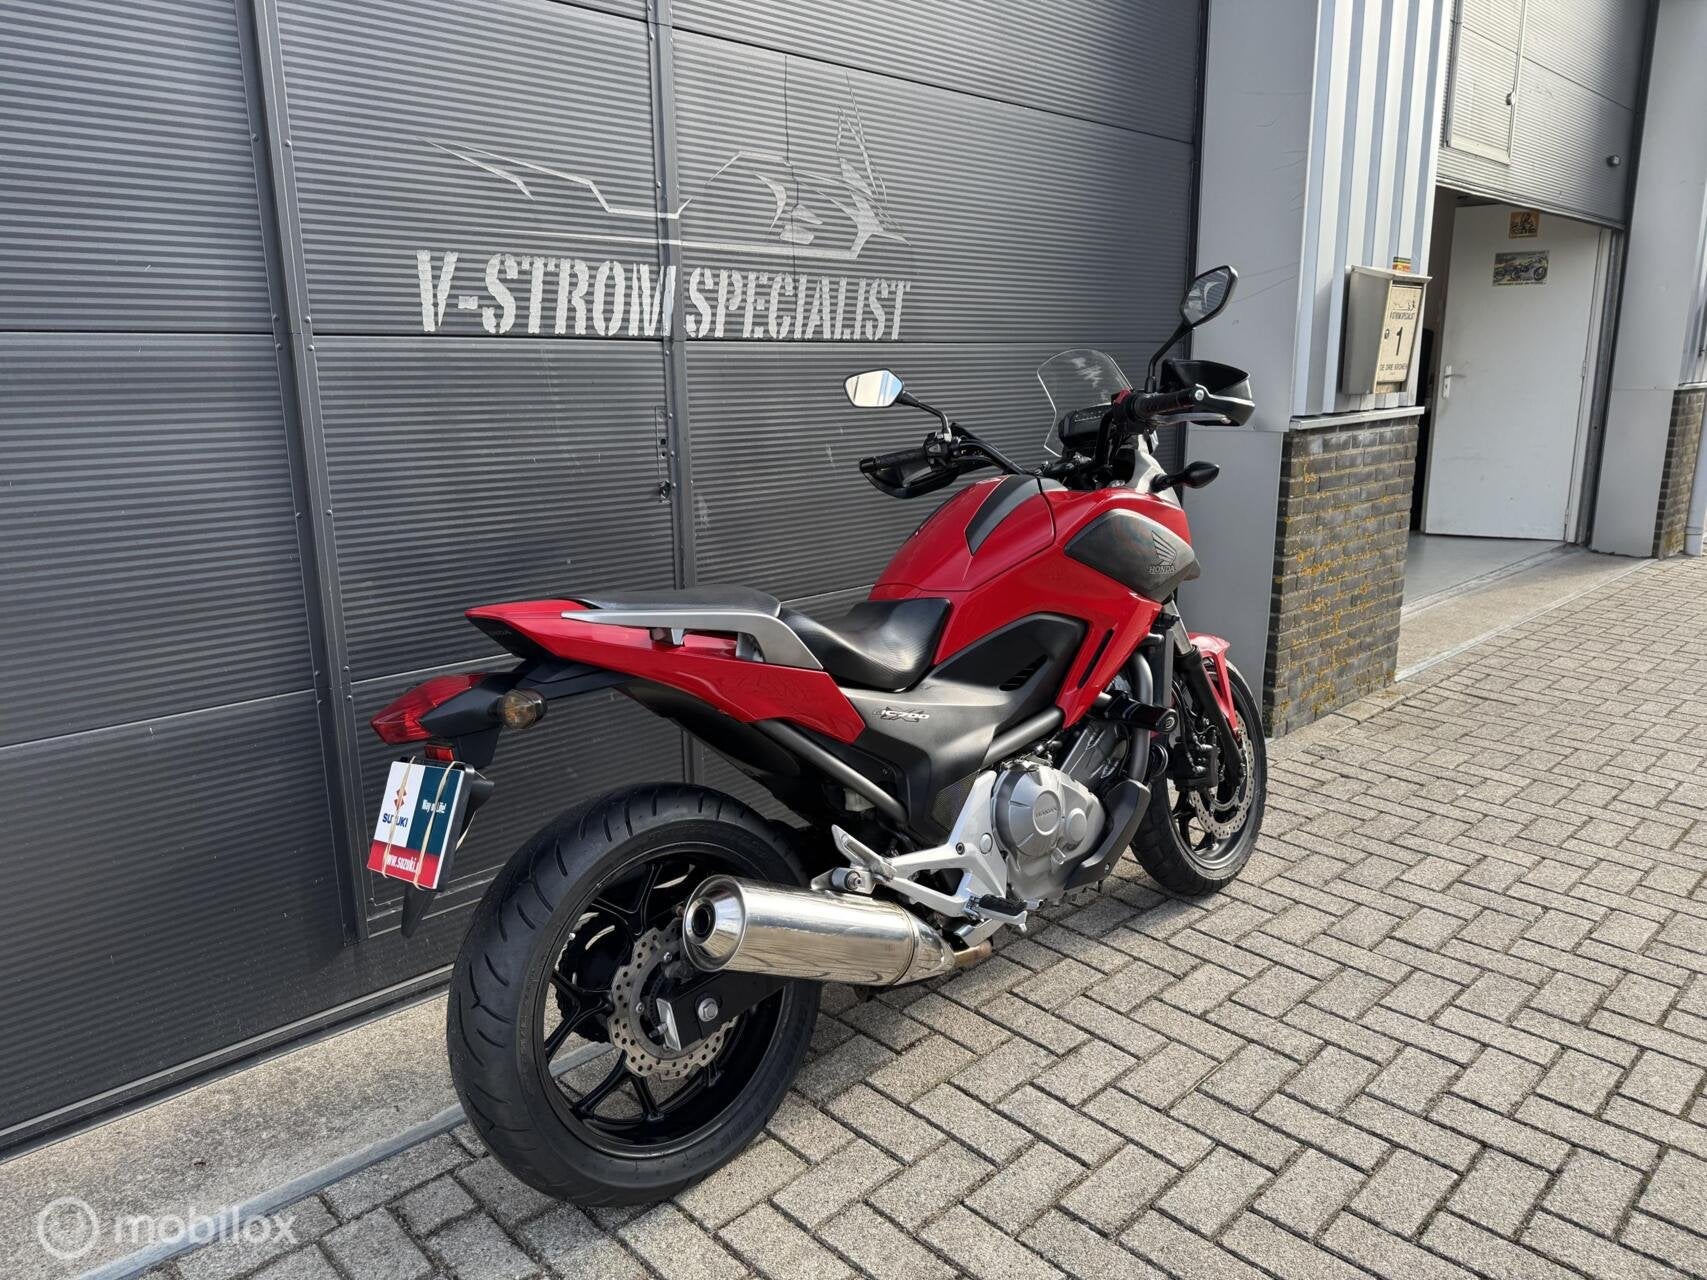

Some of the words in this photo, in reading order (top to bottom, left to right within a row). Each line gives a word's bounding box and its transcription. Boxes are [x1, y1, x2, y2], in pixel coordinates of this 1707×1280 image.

[415, 249, 677, 337] V-STROM
[685, 265, 913, 341] SPECIALIST
[1396, 326, 1403, 356] 1
[1148, 564, 1176, 575] HONDA
